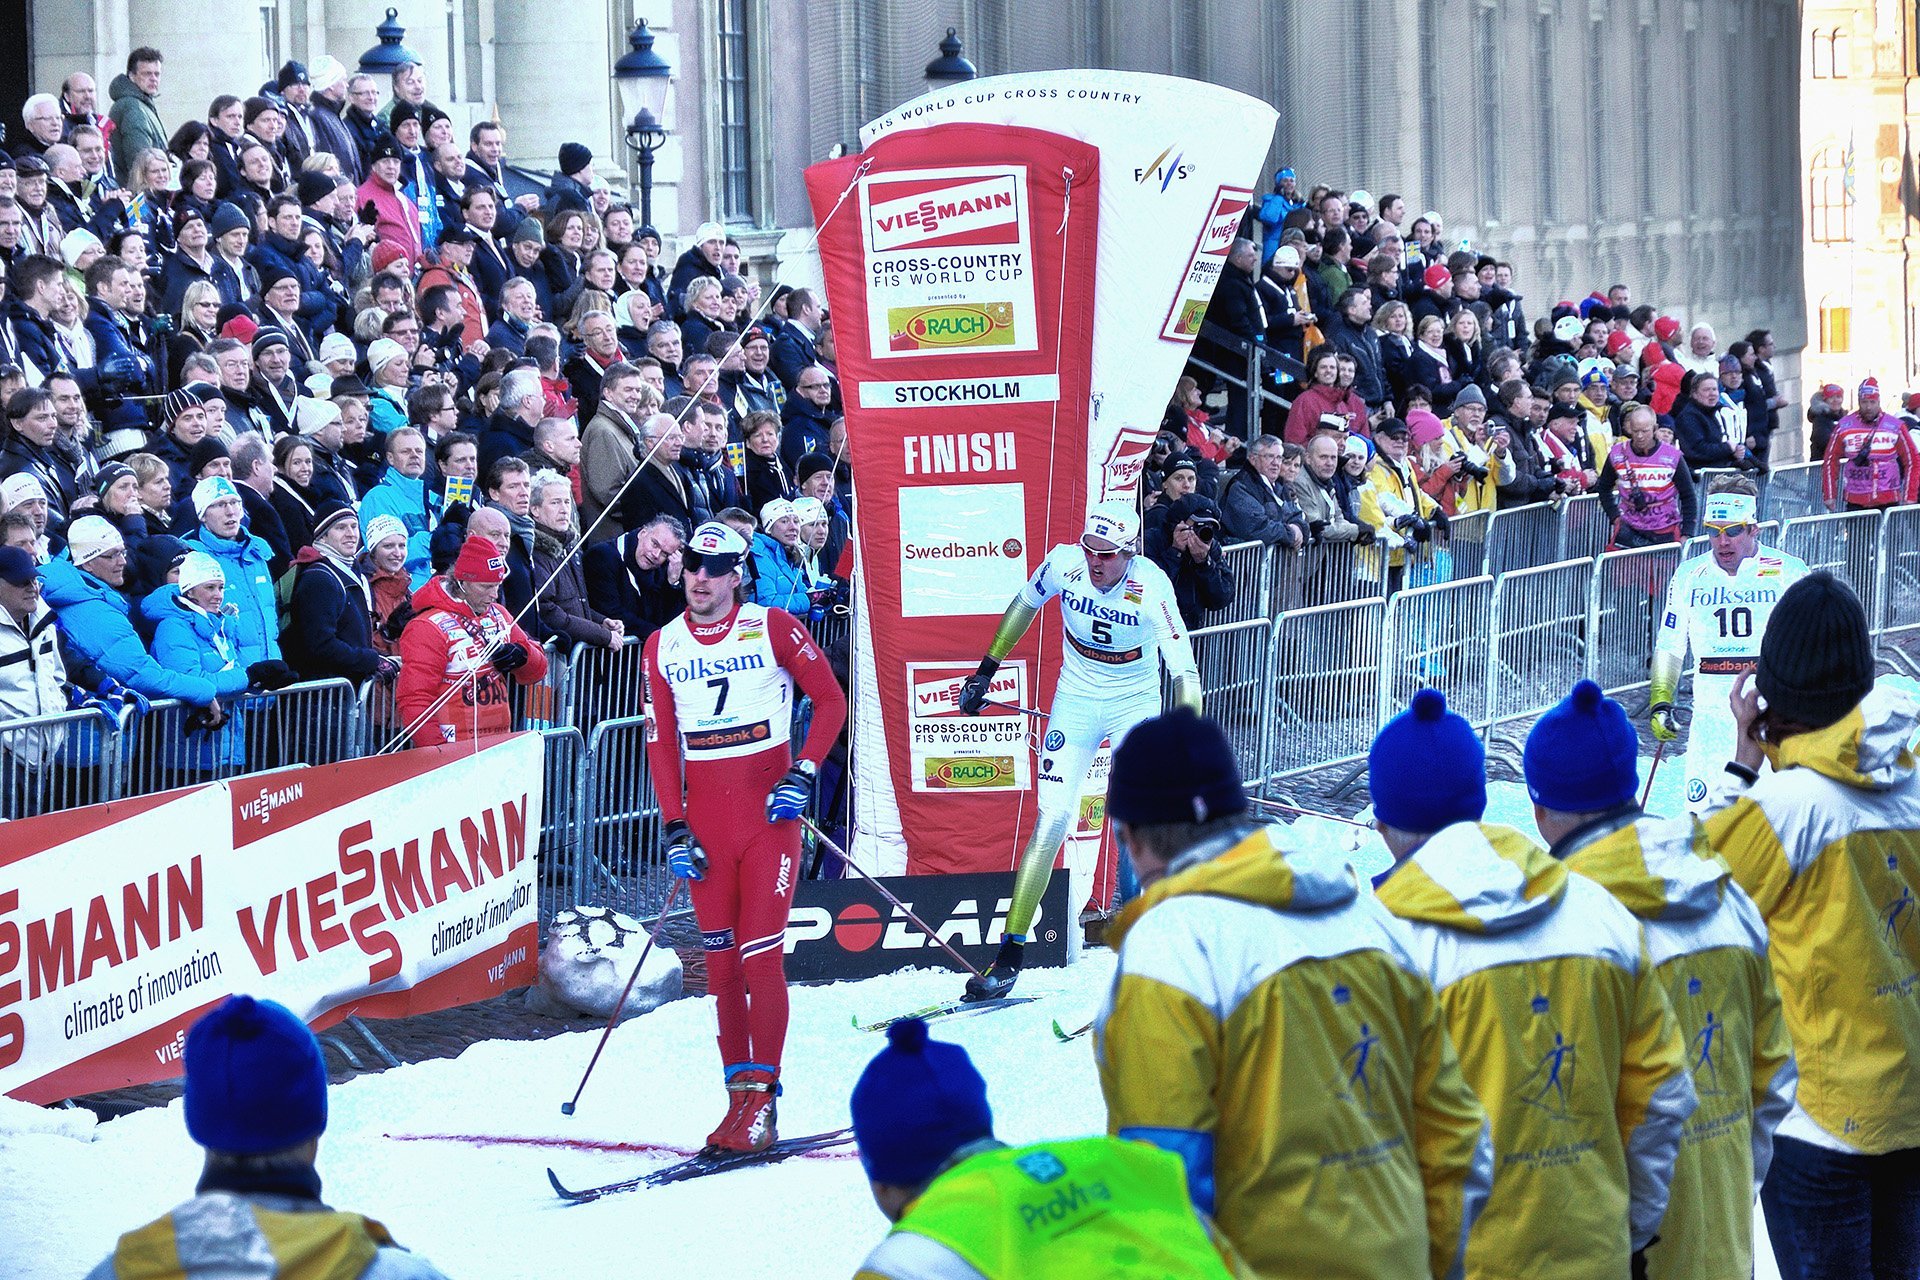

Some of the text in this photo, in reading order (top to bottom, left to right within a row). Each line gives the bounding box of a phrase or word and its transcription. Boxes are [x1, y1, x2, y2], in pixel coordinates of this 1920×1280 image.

[871, 89, 1142, 135] FIS WORLD CUP CROSS COUNTRY
[876, 191, 1012, 233] VIESSMANN
[872, 253, 1022, 274] CROSS-COUNTRY
[874, 268, 1023, 287] FIS WORLD CUP
[927, 293, 957, 301] presented
[928, 316, 985, 335] RAUCH
[895, 382, 1020, 403] STOCKHOLM
[904, 432, 1017, 475] FINISH
[905, 541, 1000, 560] Swedbank
[1061, 588, 1140, 626] Folksam
[1690, 587, 1778, 607] Folksam
[1091, 619, 1113, 645] 5
[1713, 606, 1753, 637] 10
[664, 653, 766, 685] Folksam
[1701, 660, 1757, 672] Swedbank
[706, 677, 730, 716] 7
[918, 678, 1016, 707] VIESSNN
[914, 722, 1022, 734] CROSS-COUNTRY
[915, 732, 1022, 743] FIS WORLD CUP
[953, 766, 994, 779] RAUCH
[240, 782, 303, 824] VIESSMANN
[236, 793, 527, 985] VIESSMANN
[431, 915, 474, 957] climate
[783, 898, 1043, 954] POLAR
[64, 949, 222, 1041] climate of innovation
